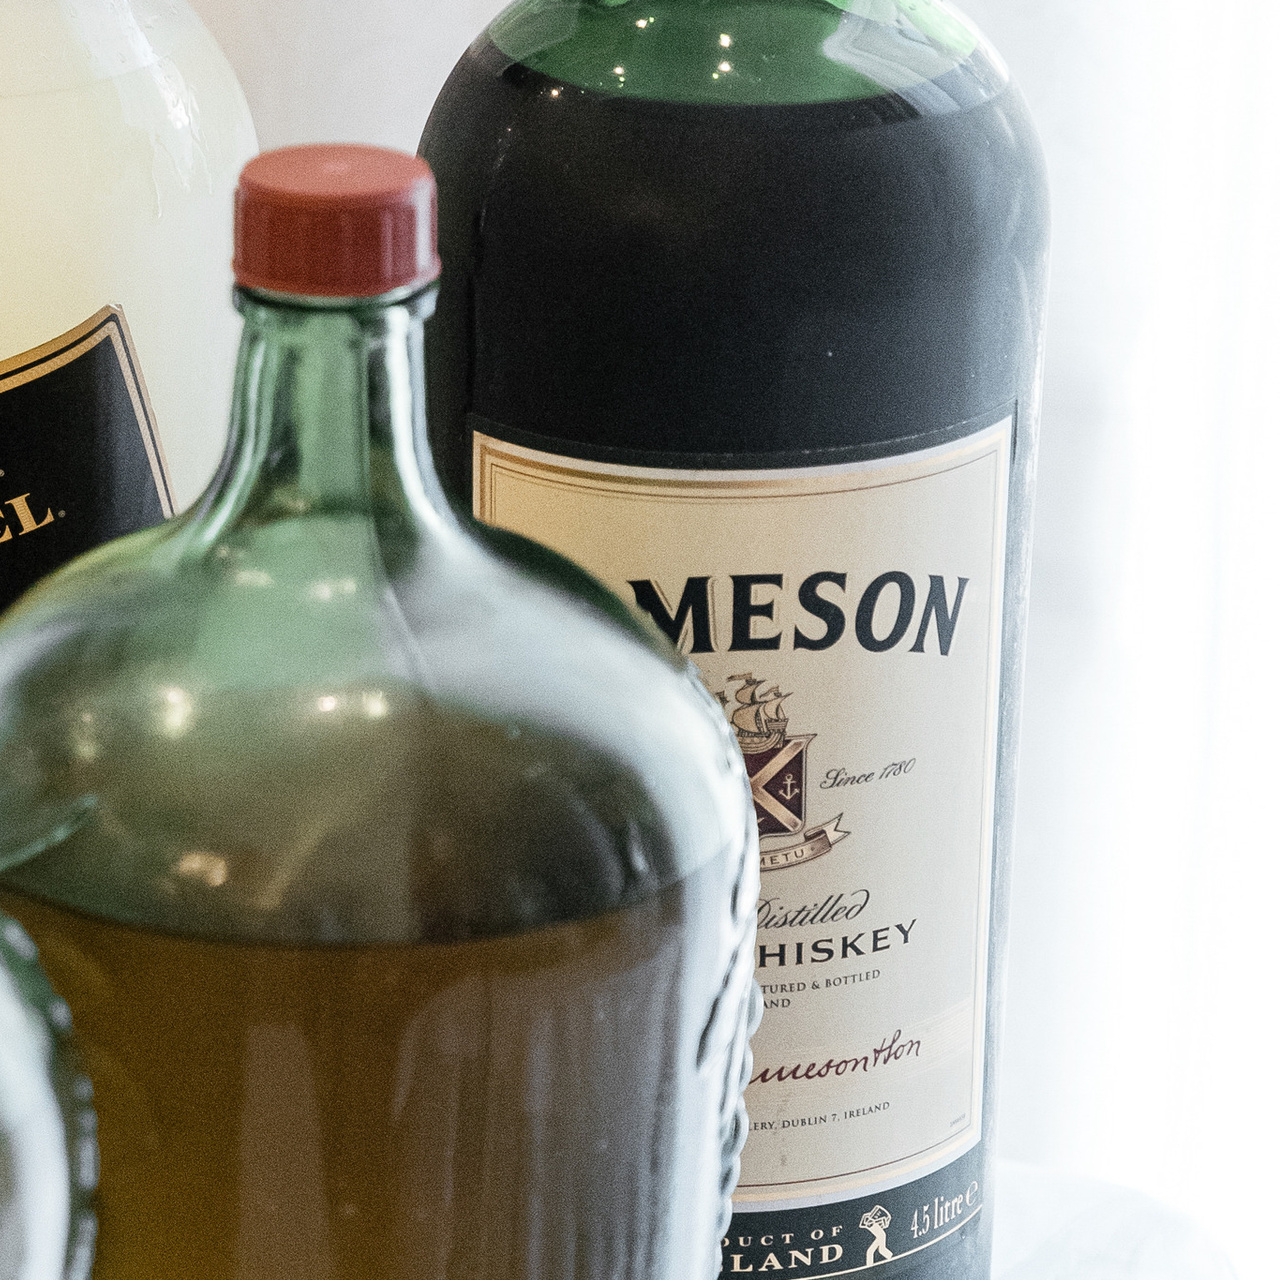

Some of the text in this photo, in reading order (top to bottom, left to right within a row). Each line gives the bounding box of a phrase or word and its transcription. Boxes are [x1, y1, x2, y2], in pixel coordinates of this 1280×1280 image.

[625, 570, 971, 657] MESON
[819, 757, 917, 790] Since 1780
[757, 917, 919, 969] HISKEY
[761, 969, 882, 995] TURED & BOTTLED
[763, 997, 792, 1010] AND
[749, 1120, 778, 1132] ERY,
[781, 1114, 828, 1130] DUBLIN
[843, 1101, 891, 1120] IRELAND
[910, 1203, 931, 1239] 4.5
[933, 1193, 964, 1230] litre
[810, 1225, 843, 1241] OF
[726, 1243, 844, 1273] LAND
